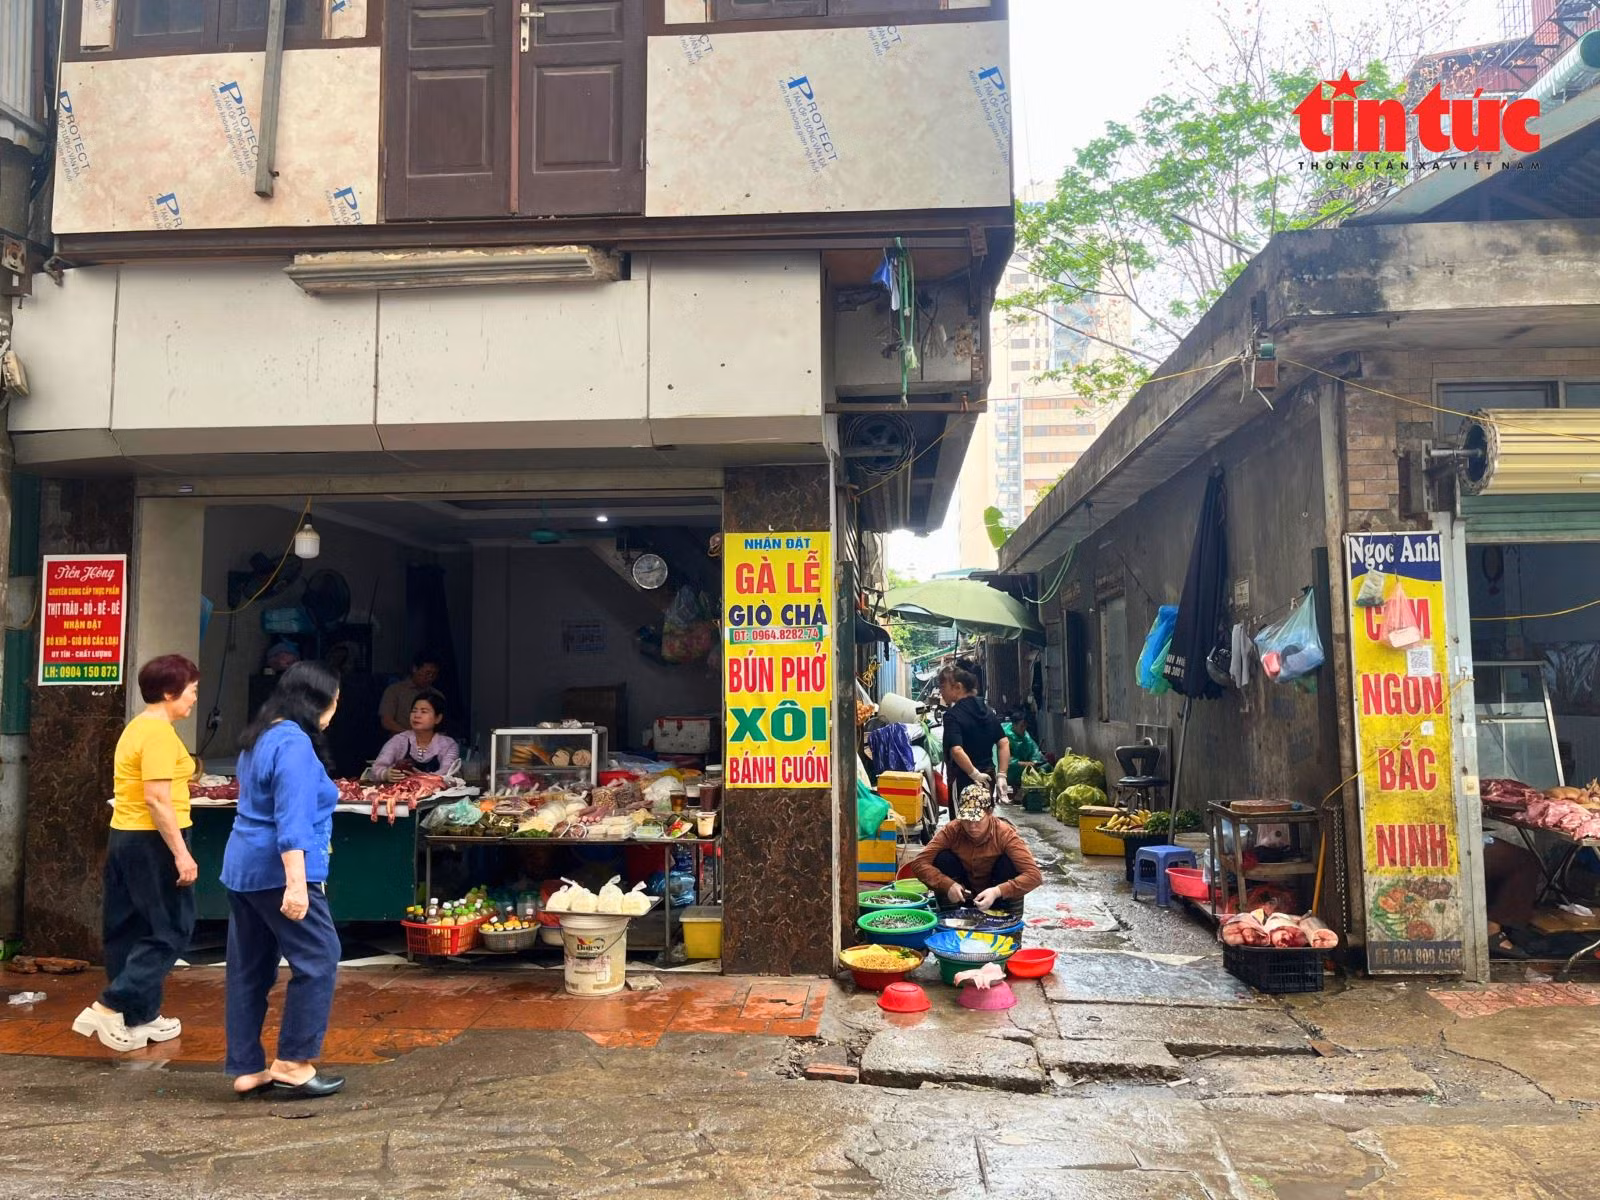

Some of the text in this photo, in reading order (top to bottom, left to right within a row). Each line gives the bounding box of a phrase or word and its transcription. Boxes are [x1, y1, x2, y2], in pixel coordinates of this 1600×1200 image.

[219, 81, 260, 161] PROTEC
[787, 76, 837, 160] PROTECT
[744, 537, 811, 552] NHẬN ĐẶT
[1350, 536, 1440, 570] Ngọc Anh
[735, 550, 821, 594] GÀ LỄ
[47, 603, 61, 618] THỊT
[62, 600, 79, 615] TRÂU
[63, 619, 102, 631] NHẬN ĐẶT
[728, 598, 827, 626] GIÒ CHẢ
[1365, 598, 1431, 641] CM
[92, 634, 104, 646] CÁC
[104, 636, 119, 647] LOẠI
[733, 628, 819, 641] ĐT: 0964.8282.74
[45, 666, 117, 678] LH: 0904 150 873
[60, 650, 71, 658] TÍN
[75, 649, 91, 658] CHẤT
[91, 650, 112, 659] LƯỢNG
[728, 642, 827, 693] BÚN PHỞ
[1362, 673, 1444, 715] NGON
[728, 700, 827, 743] XÔI
[729, 746, 829, 784] BÁNH CUỐN
[1378, 732, 1437, 790] BẮC
[1375, 824, 1449, 867] NINH
